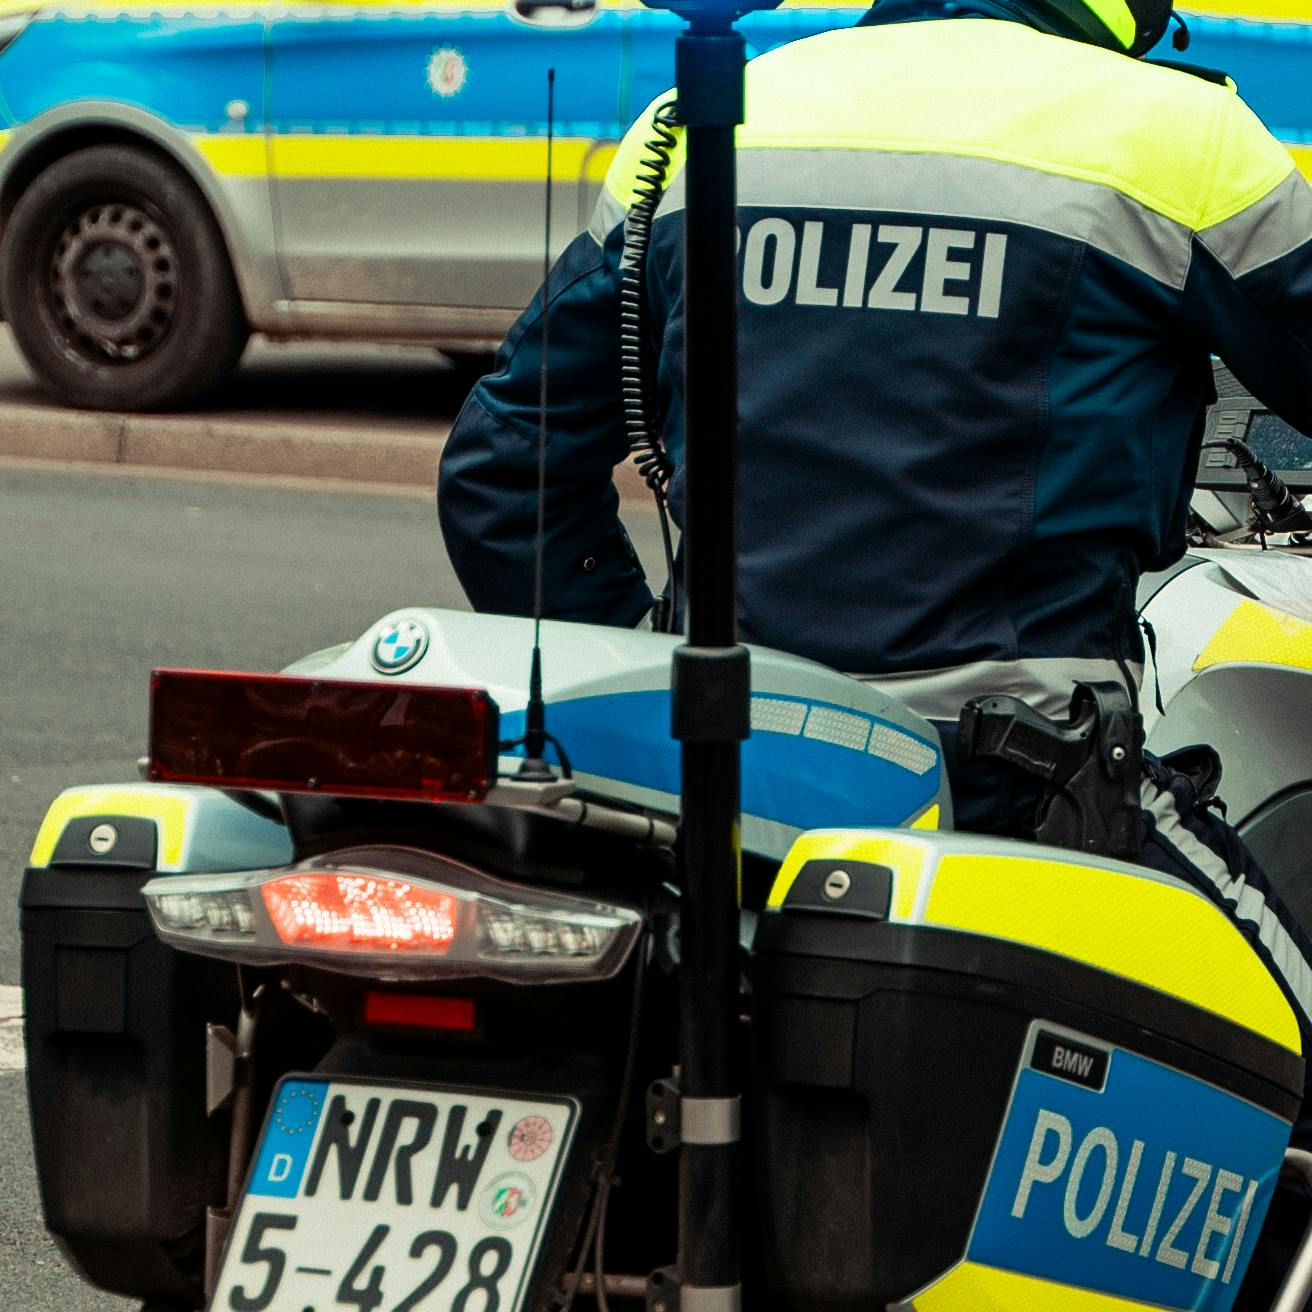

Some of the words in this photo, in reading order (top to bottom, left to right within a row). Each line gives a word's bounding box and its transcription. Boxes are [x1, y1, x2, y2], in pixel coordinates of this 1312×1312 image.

[736, 217, 1008, 318] OLIZEI
[1052, 1046, 1094, 1077] BMW
[267, 1153, 294, 1183] D
[304, 1094, 503, 1211] NRW
[1011, 1109, 1258, 1284] POLIZEI
